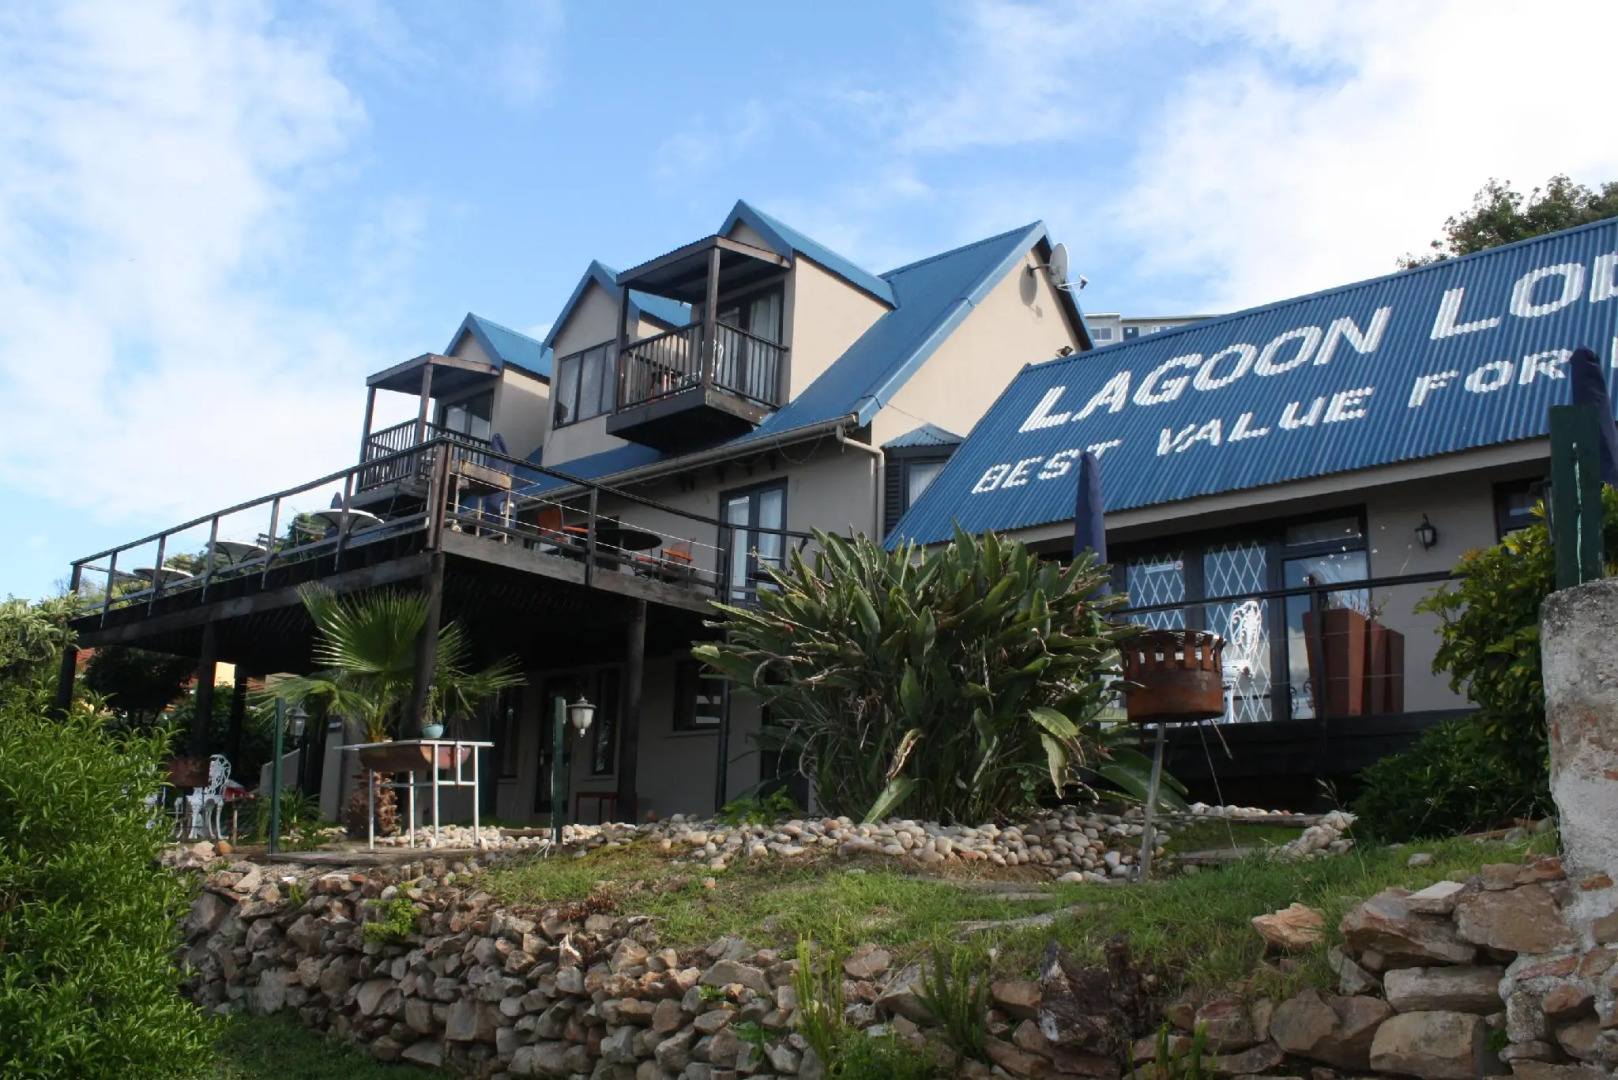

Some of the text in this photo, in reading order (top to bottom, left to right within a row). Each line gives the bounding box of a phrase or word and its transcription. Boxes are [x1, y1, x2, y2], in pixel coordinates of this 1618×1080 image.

[1018, 306, 1391, 433] LAGOON
[1157, 386, 1375, 456] VALUE
[1408, 348, 1573, 408] FOR
